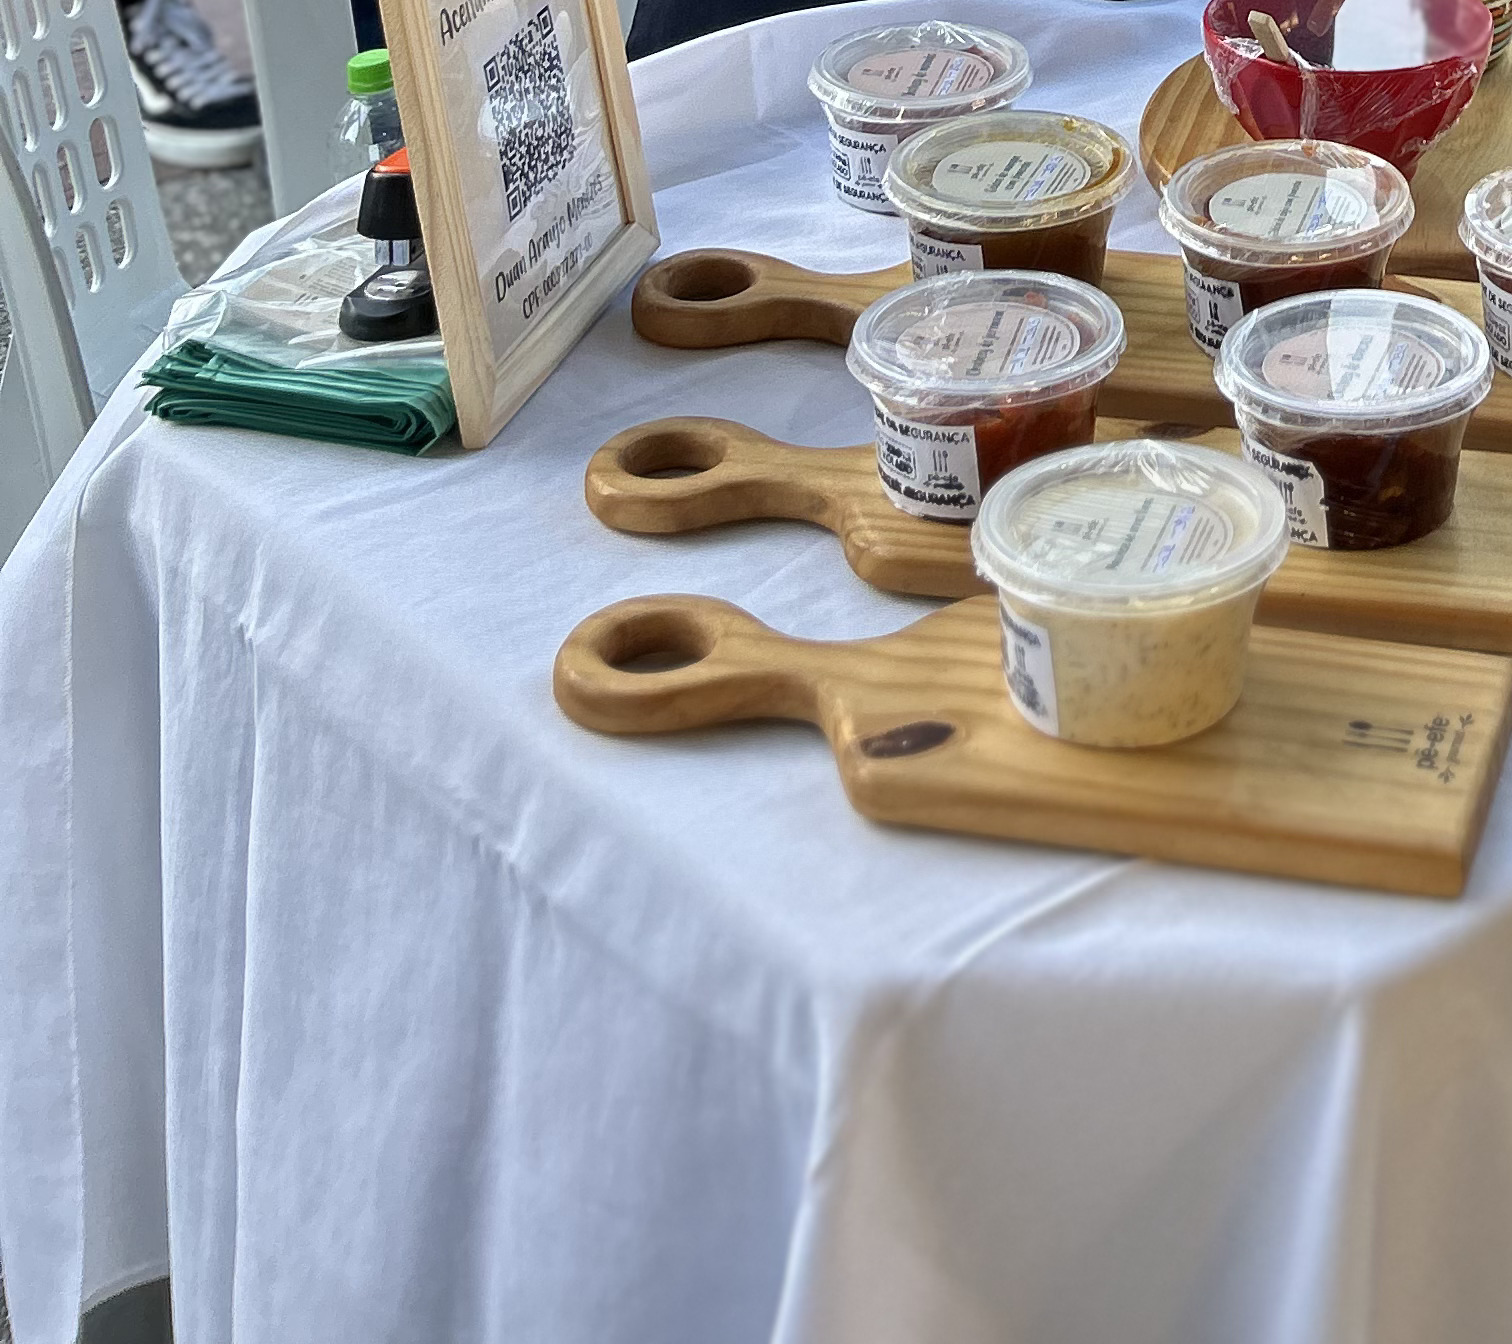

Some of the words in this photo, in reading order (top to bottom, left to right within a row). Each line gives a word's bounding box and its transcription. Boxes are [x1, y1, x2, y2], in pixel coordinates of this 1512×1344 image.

[495, 255, 528, 304] Duan
[528, 214, 566, 270] Araujo
[898, 423, 971, 446] SEGURANÇA
